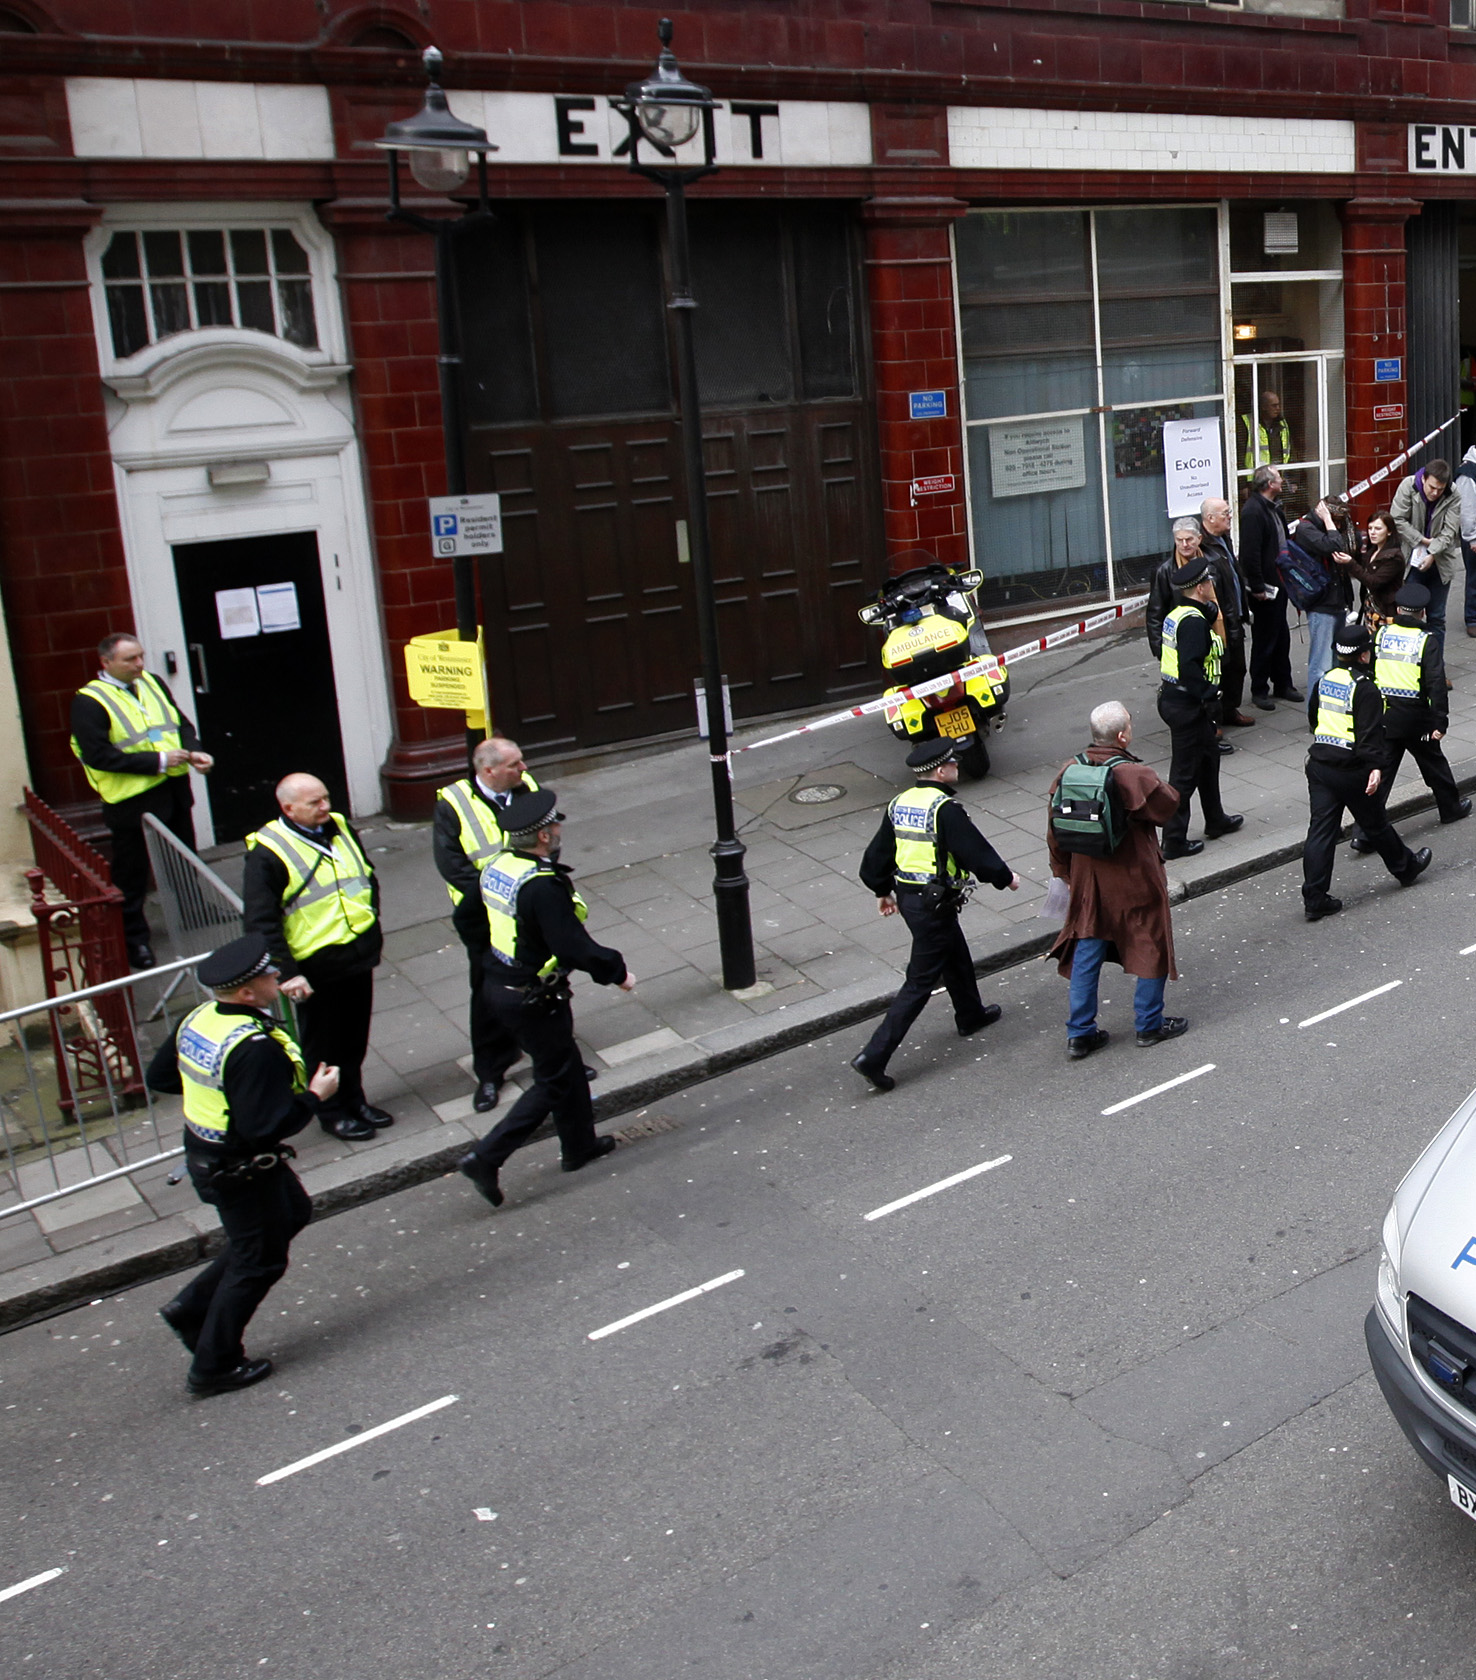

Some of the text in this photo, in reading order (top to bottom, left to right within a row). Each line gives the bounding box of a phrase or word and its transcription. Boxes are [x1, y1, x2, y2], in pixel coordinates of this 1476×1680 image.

[913, 400, 943, 409] PARKING
[1175, 458, 1211, 471] ExCon
[923, 477, 945, 486] WEIGHT
[438, 516, 454, 535] P
[460, 515, 497, 523] Resident
[464, 523, 493, 532] permit
[471, 540, 489, 548] only
[891, 629, 951, 656] AMBULANCE
[420, 664, 473, 677] WARNING
[1321, 685, 1346, 699] POLICE
[937, 708, 970, 727] LJ05
[945, 722, 970, 738] FHU
[895, 813, 924, 828] POLICE
[484, 874, 511, 899] POLICE
[181, 1037, 213, 1068] POLICE
